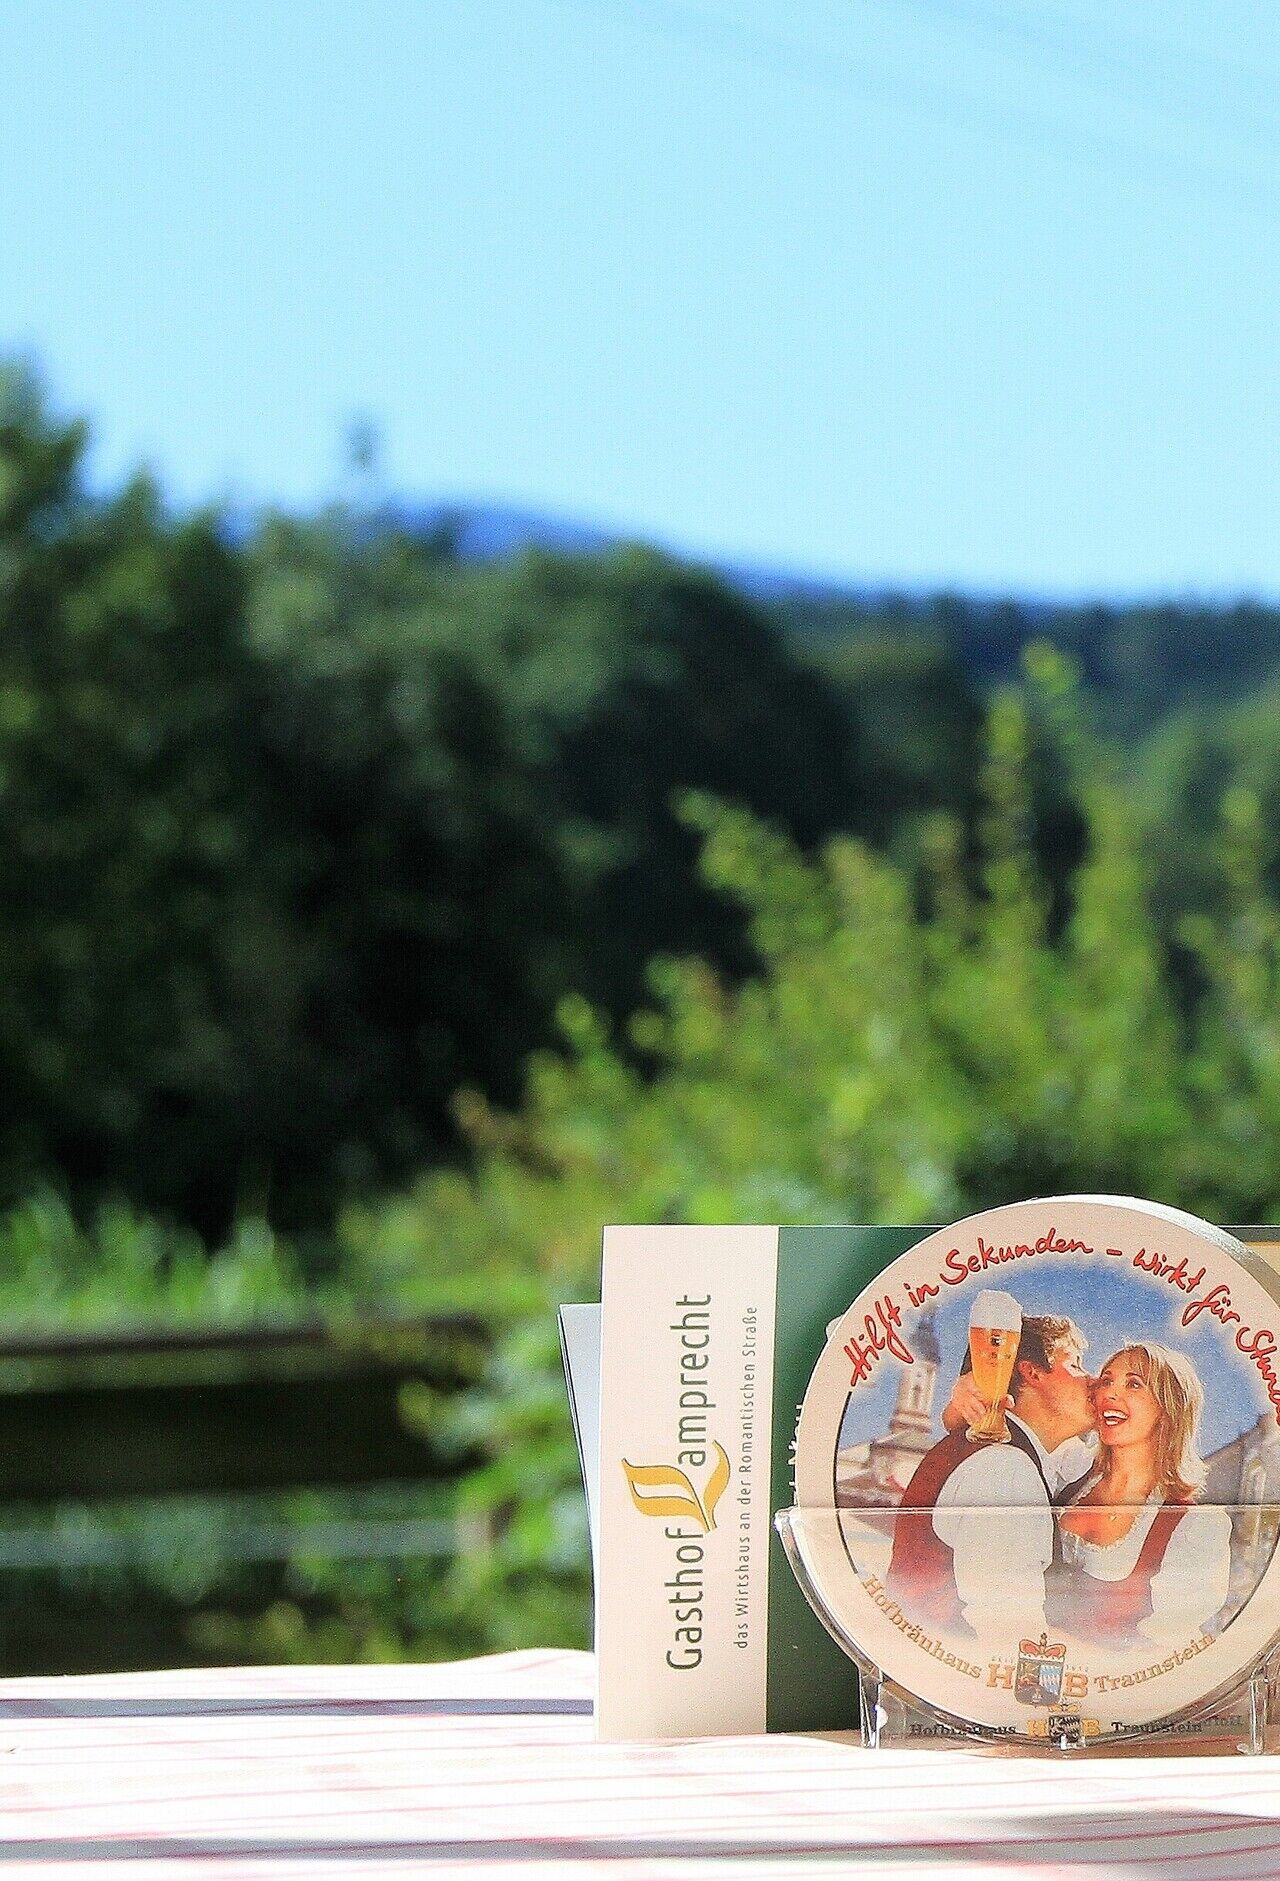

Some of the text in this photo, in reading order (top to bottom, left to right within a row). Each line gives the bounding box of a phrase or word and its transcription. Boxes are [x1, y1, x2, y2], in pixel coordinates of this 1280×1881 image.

[844, 1295, 914, 1386] Hilft
[904, 1282, 939, 1307] in
[939, 1227, 1093, 1285] Sekunden
[1181, 1284, 1240, 1327] für
[733, 1306, 758, 1649] das Wirtshaus an der Romantischen Straße
[664, 1526, 704, 1671] Gasthof
[861, 1573, 982, 1679] Hofbräuhaus
[1093, 1633, 1217, 1693] Traunstein
